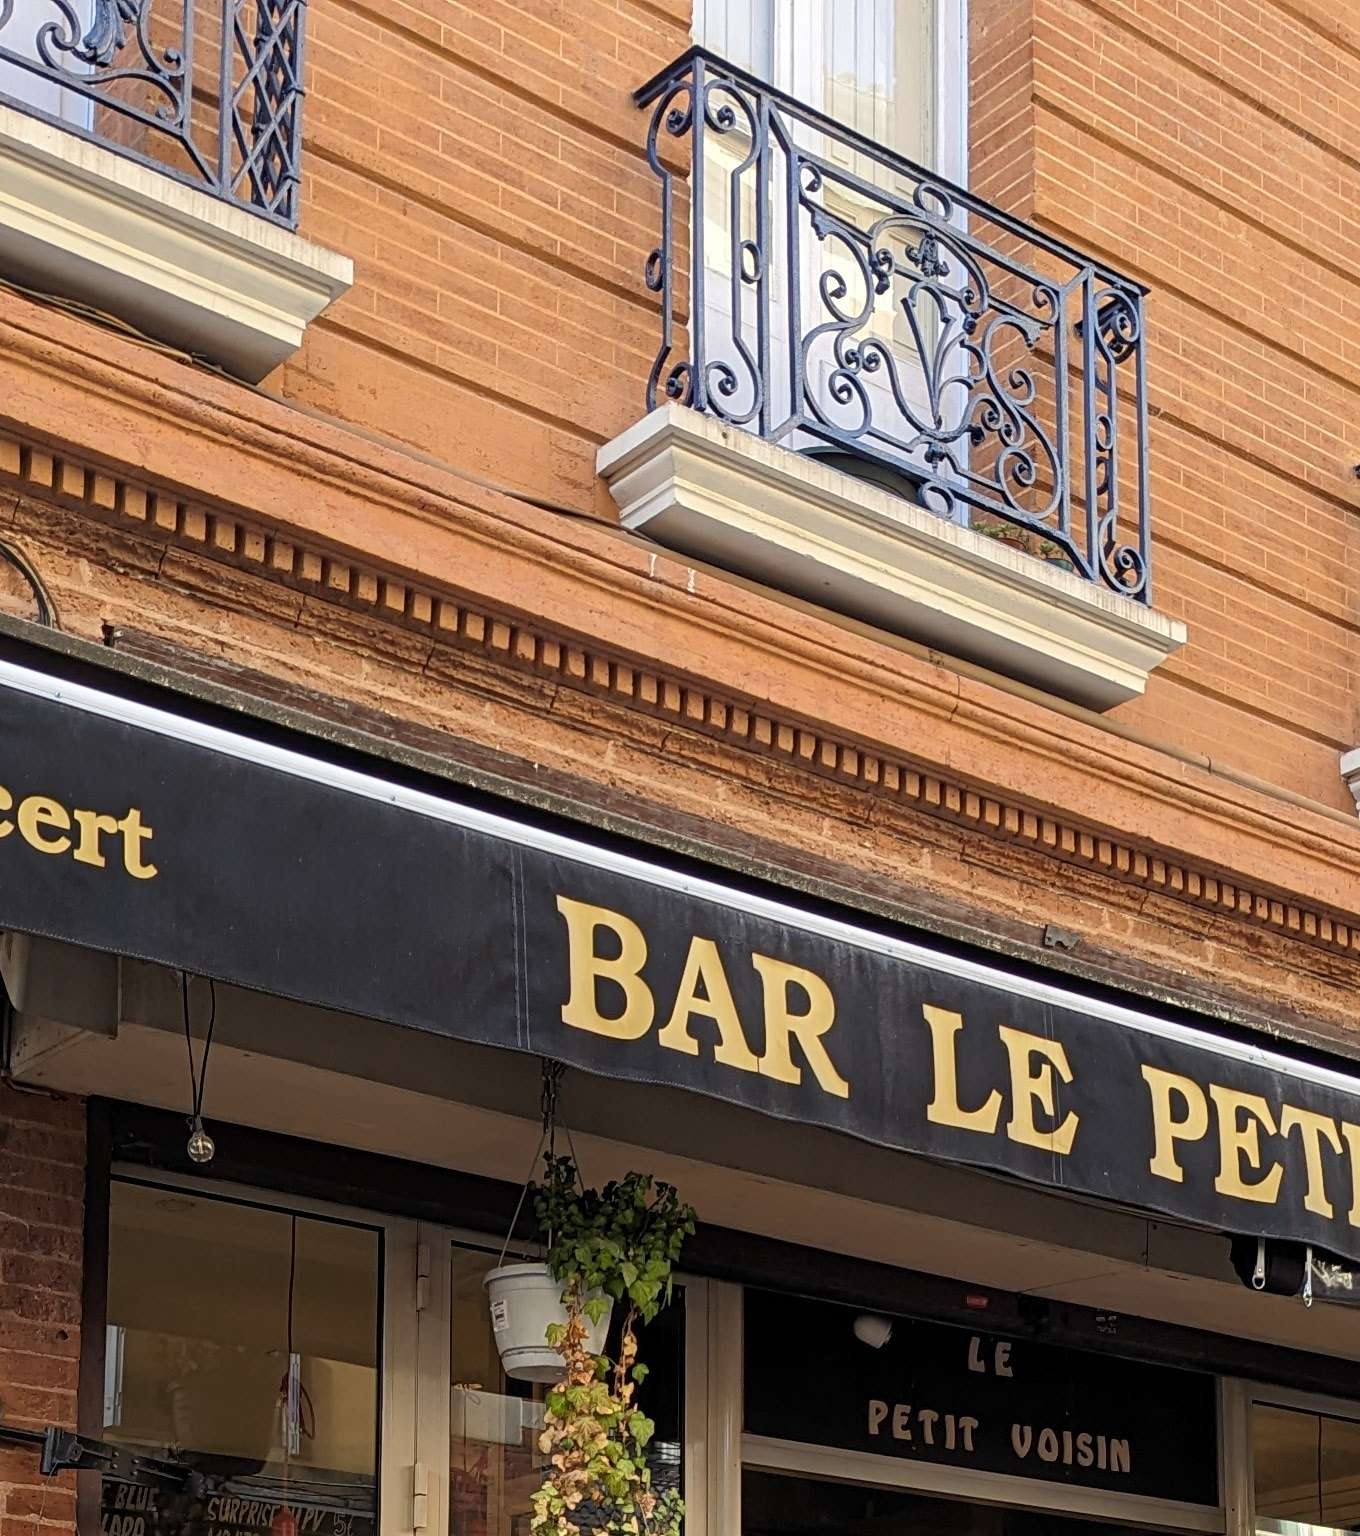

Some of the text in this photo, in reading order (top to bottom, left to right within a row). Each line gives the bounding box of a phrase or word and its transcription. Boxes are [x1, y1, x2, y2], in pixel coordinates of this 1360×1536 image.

[556, 889, 854, 1099] BAR
[922, 999, 1084, 1155] LE
[967, 1336, 1014, 1378] LE
[868, 1400, 1131, 1473] PETIT VOISIN
